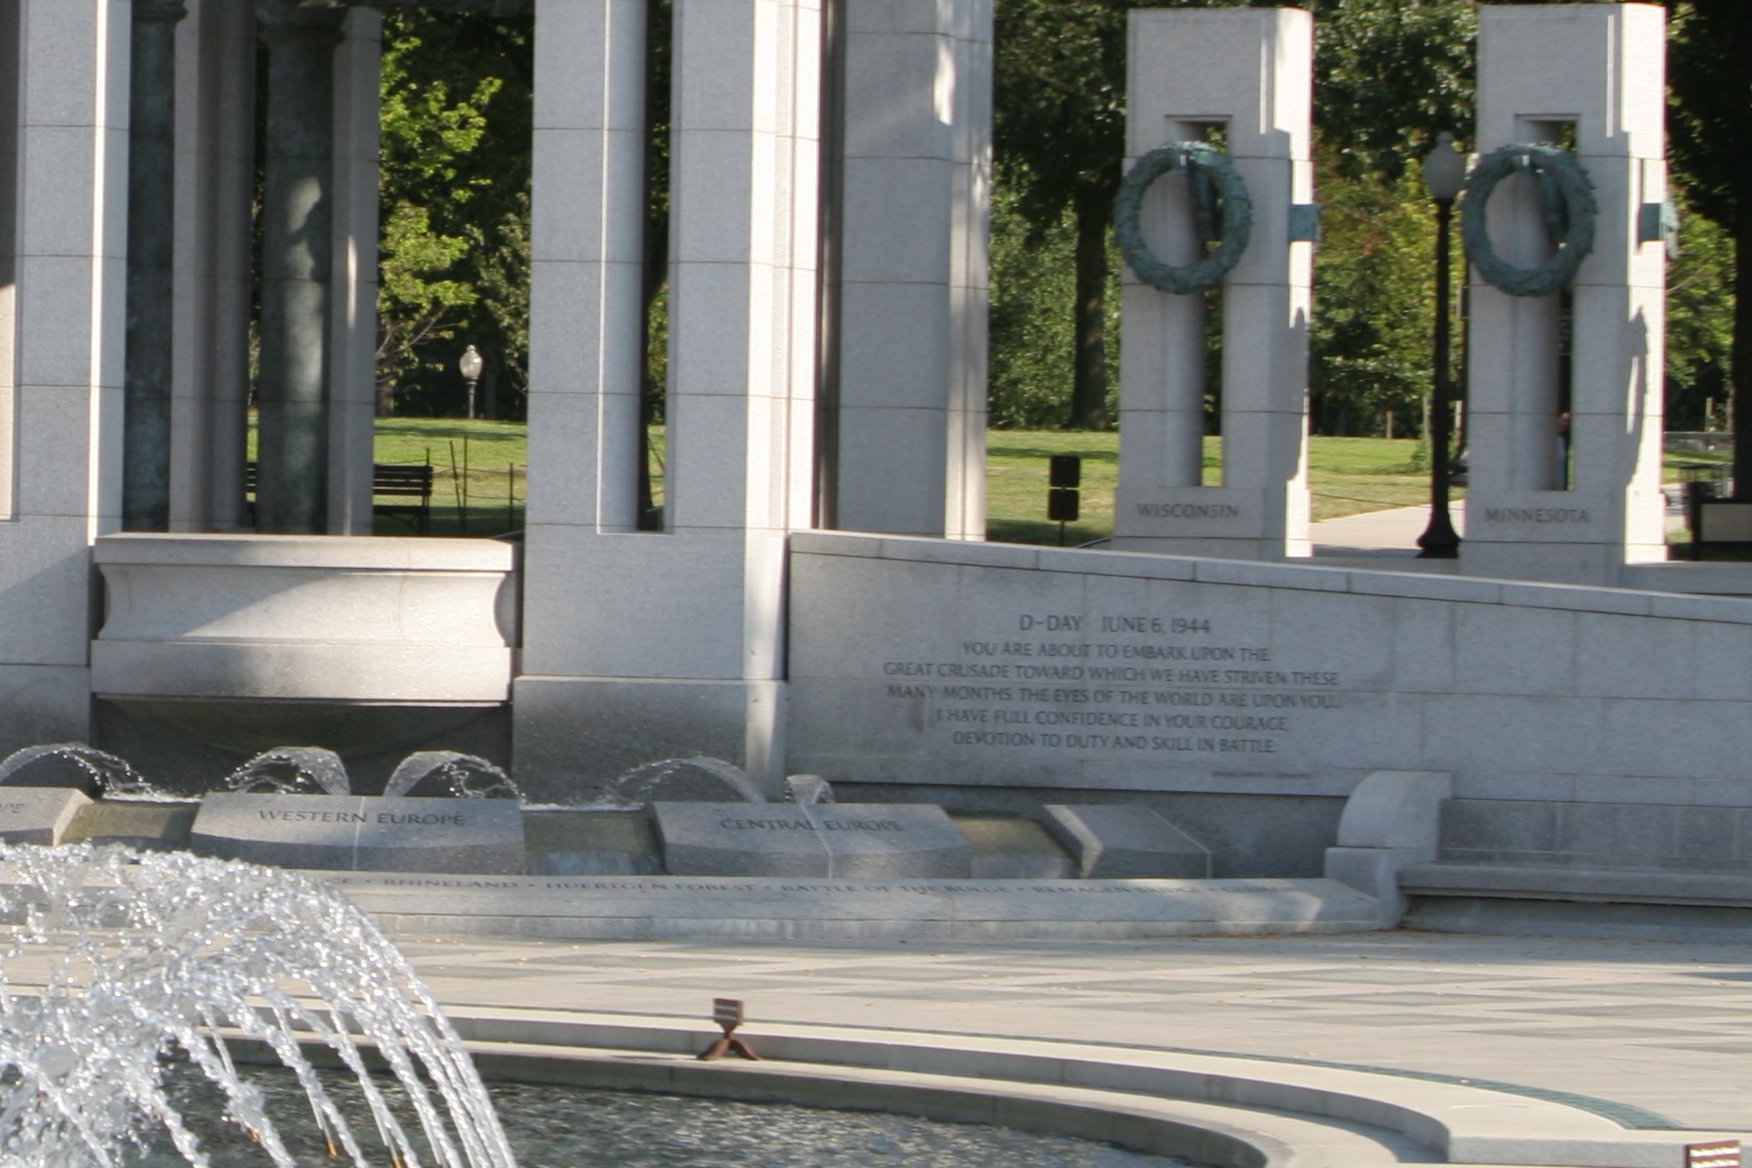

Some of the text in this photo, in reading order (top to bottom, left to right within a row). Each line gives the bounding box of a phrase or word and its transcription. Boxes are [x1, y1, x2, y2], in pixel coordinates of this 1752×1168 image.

[1137, 503, 1240, 518] WISCONSIN
[1484, 508, 1591, 523] MINNESOTA
[1018, 615, 1211, 636] D-DAY JUNE 6, 1944
[962, 642, 1270, 662] YOU ARE ABOUT TO EMBARK UPON THE
[883, 662, 1340, 686] GREAT CRUSADE TOWARD WHICH WE HAVE STRIVEN THESE
[887, 685, 934, 699] MANY
[1018, 688, 1049, 702] THE
[1053, 688, 1090, 703] EYES
[1093, 690, 1114, 704] OF
[1118, 691, 1149, 705] THE
[1154, 692, 1214, 706] WORLD
[1218, 693, 1248, 707] ARE
[1252, 694, 1298, 708] UPON
[936, 709, 943, 722] I
[947, 709, 988, 723] HAVE
[992, 710, 1030, 724] FULL
[1034, 710, 1138, 727] CONFIDENCE
[1142, 714, 1161, 728] IN
[1162, 714, 1208, 729] YOUR
[953, 731, 1035, 746] DEVOTION
[1040, 734, 1062, 748] TO
[1066, 734, 1108, 749] DUTY
[1112, 735, 1148, 750] AND
[1152, 736, 1194, 751] SKILL
[1197, 738, 1214, 752] IN
[259, 810, 467, 826] WESTERN EUROPE
[720, 818, 905, 832] CENTRAL EUROPE
[383, 878, 518, 888] RHINELAND
[781, 884, 859, 892] BATTLE
